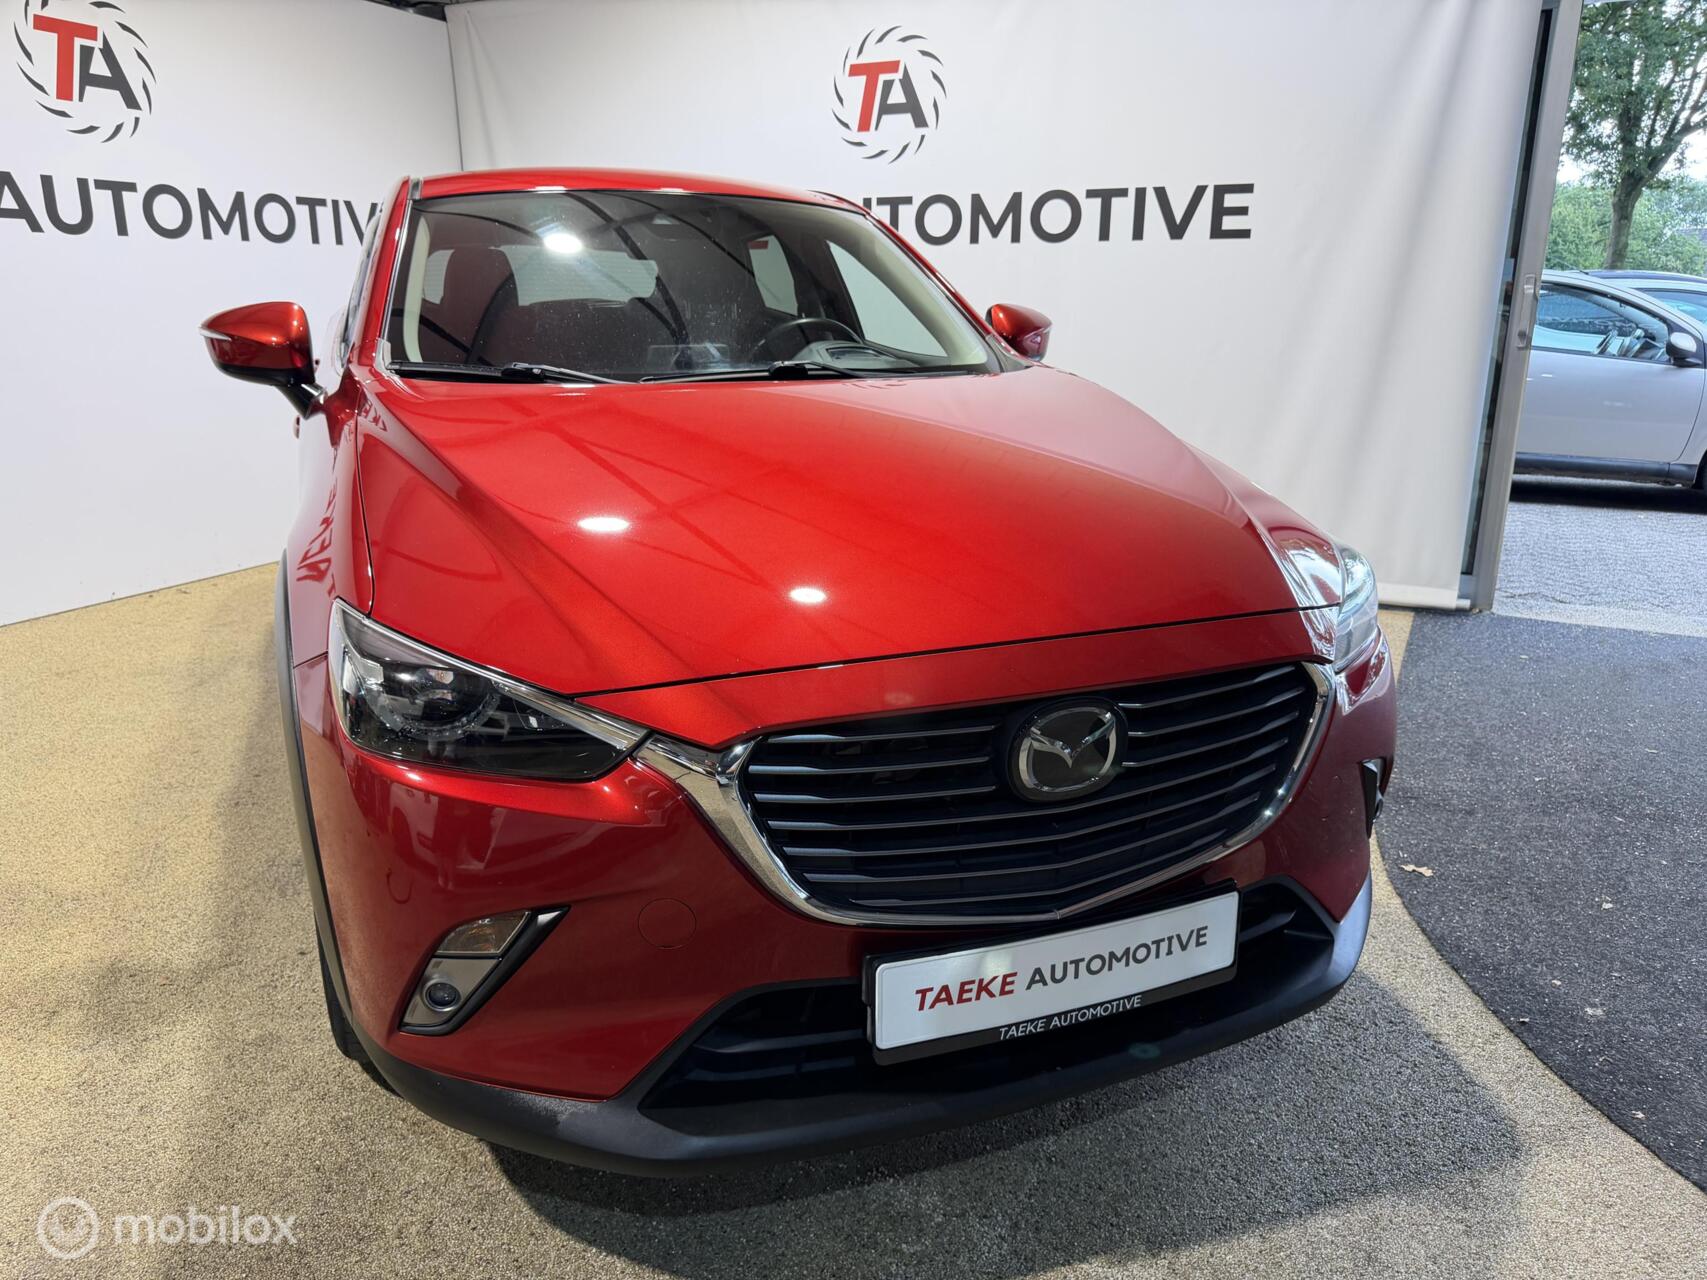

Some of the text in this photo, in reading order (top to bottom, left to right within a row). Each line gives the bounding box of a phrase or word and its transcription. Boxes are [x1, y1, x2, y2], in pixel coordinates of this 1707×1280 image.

[33, 14, 142, 111] TA
[848, 59, 929, 133] TA
[863, 183, 1255, 246] TOMOTIVE
[915, 925, 1209, 1012] TAEKE AUTOMOTIVE
[999, 995, 1142, 1041] TAEKE AUTOMOTIVE
